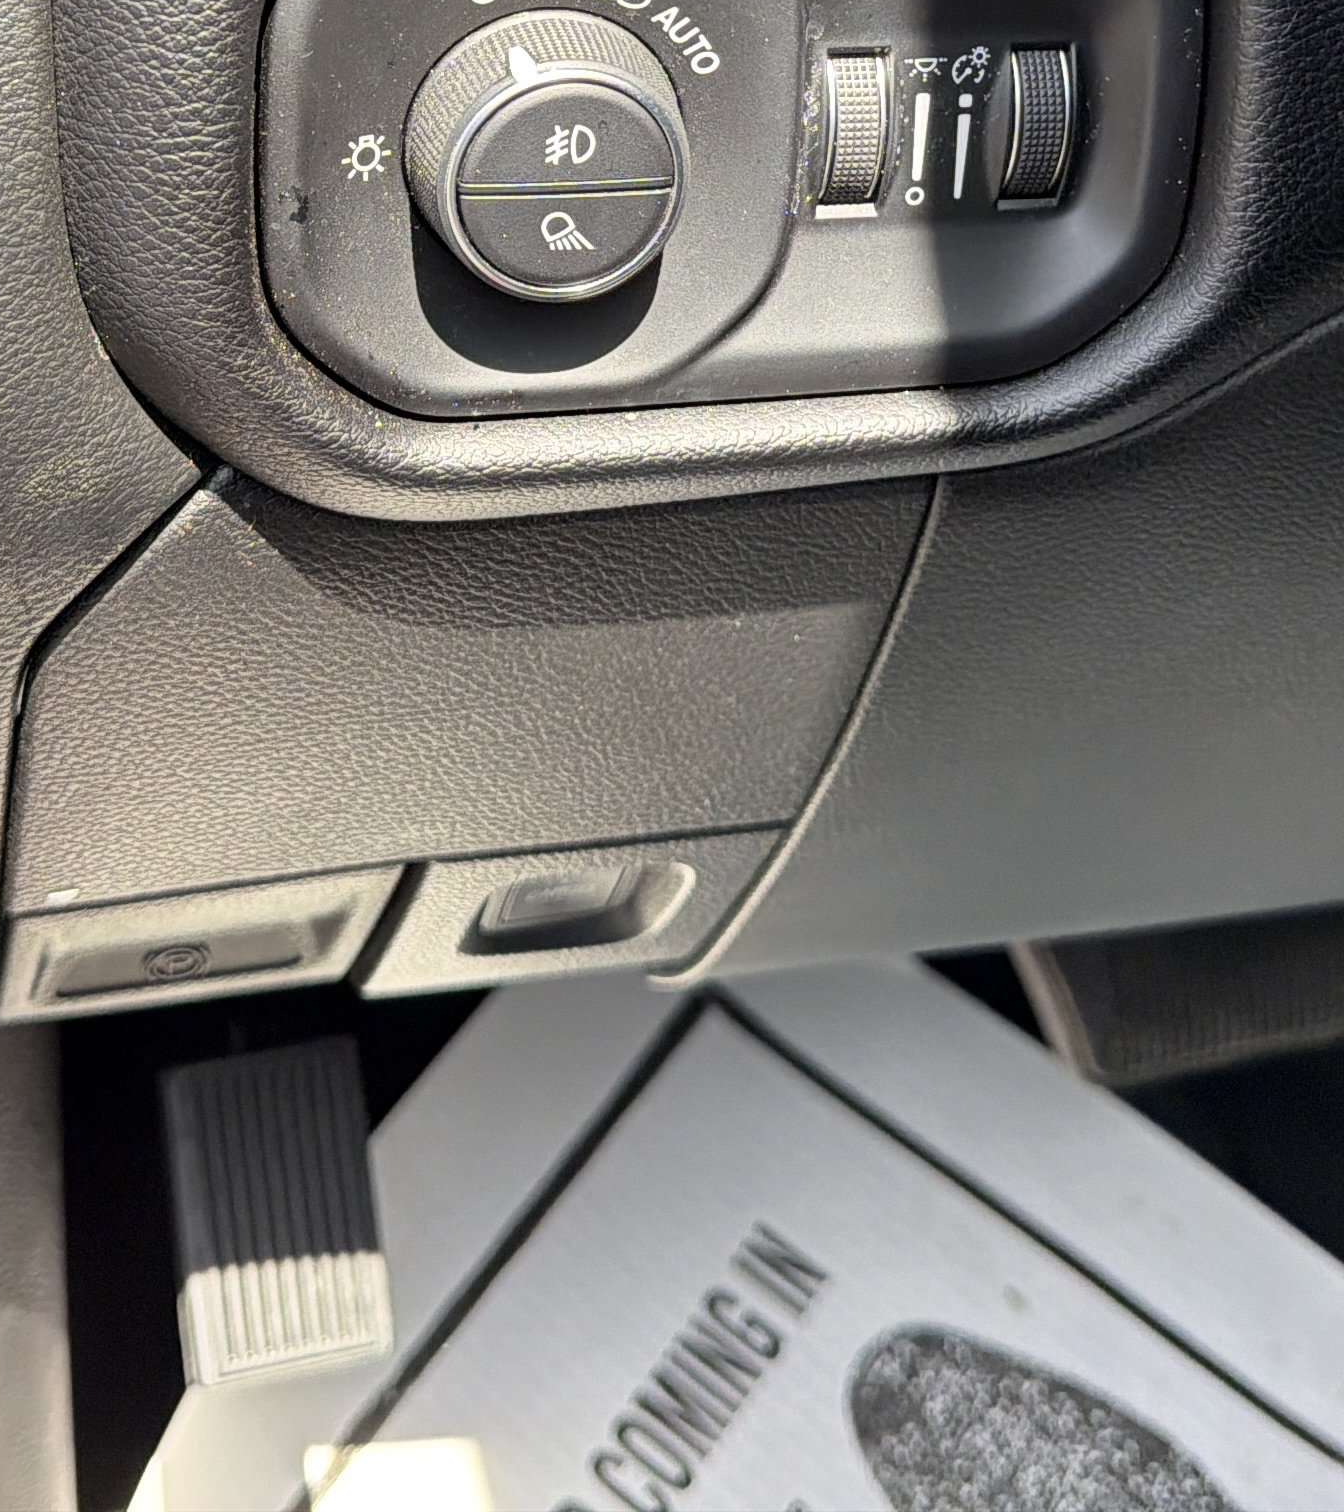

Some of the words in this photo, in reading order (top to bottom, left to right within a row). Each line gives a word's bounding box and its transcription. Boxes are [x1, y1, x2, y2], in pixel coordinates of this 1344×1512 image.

[651, 6, 720, 76] AUTO
[588, 1286, 785, 1512] COMING
[730, 1219, 829, 1315] IN
